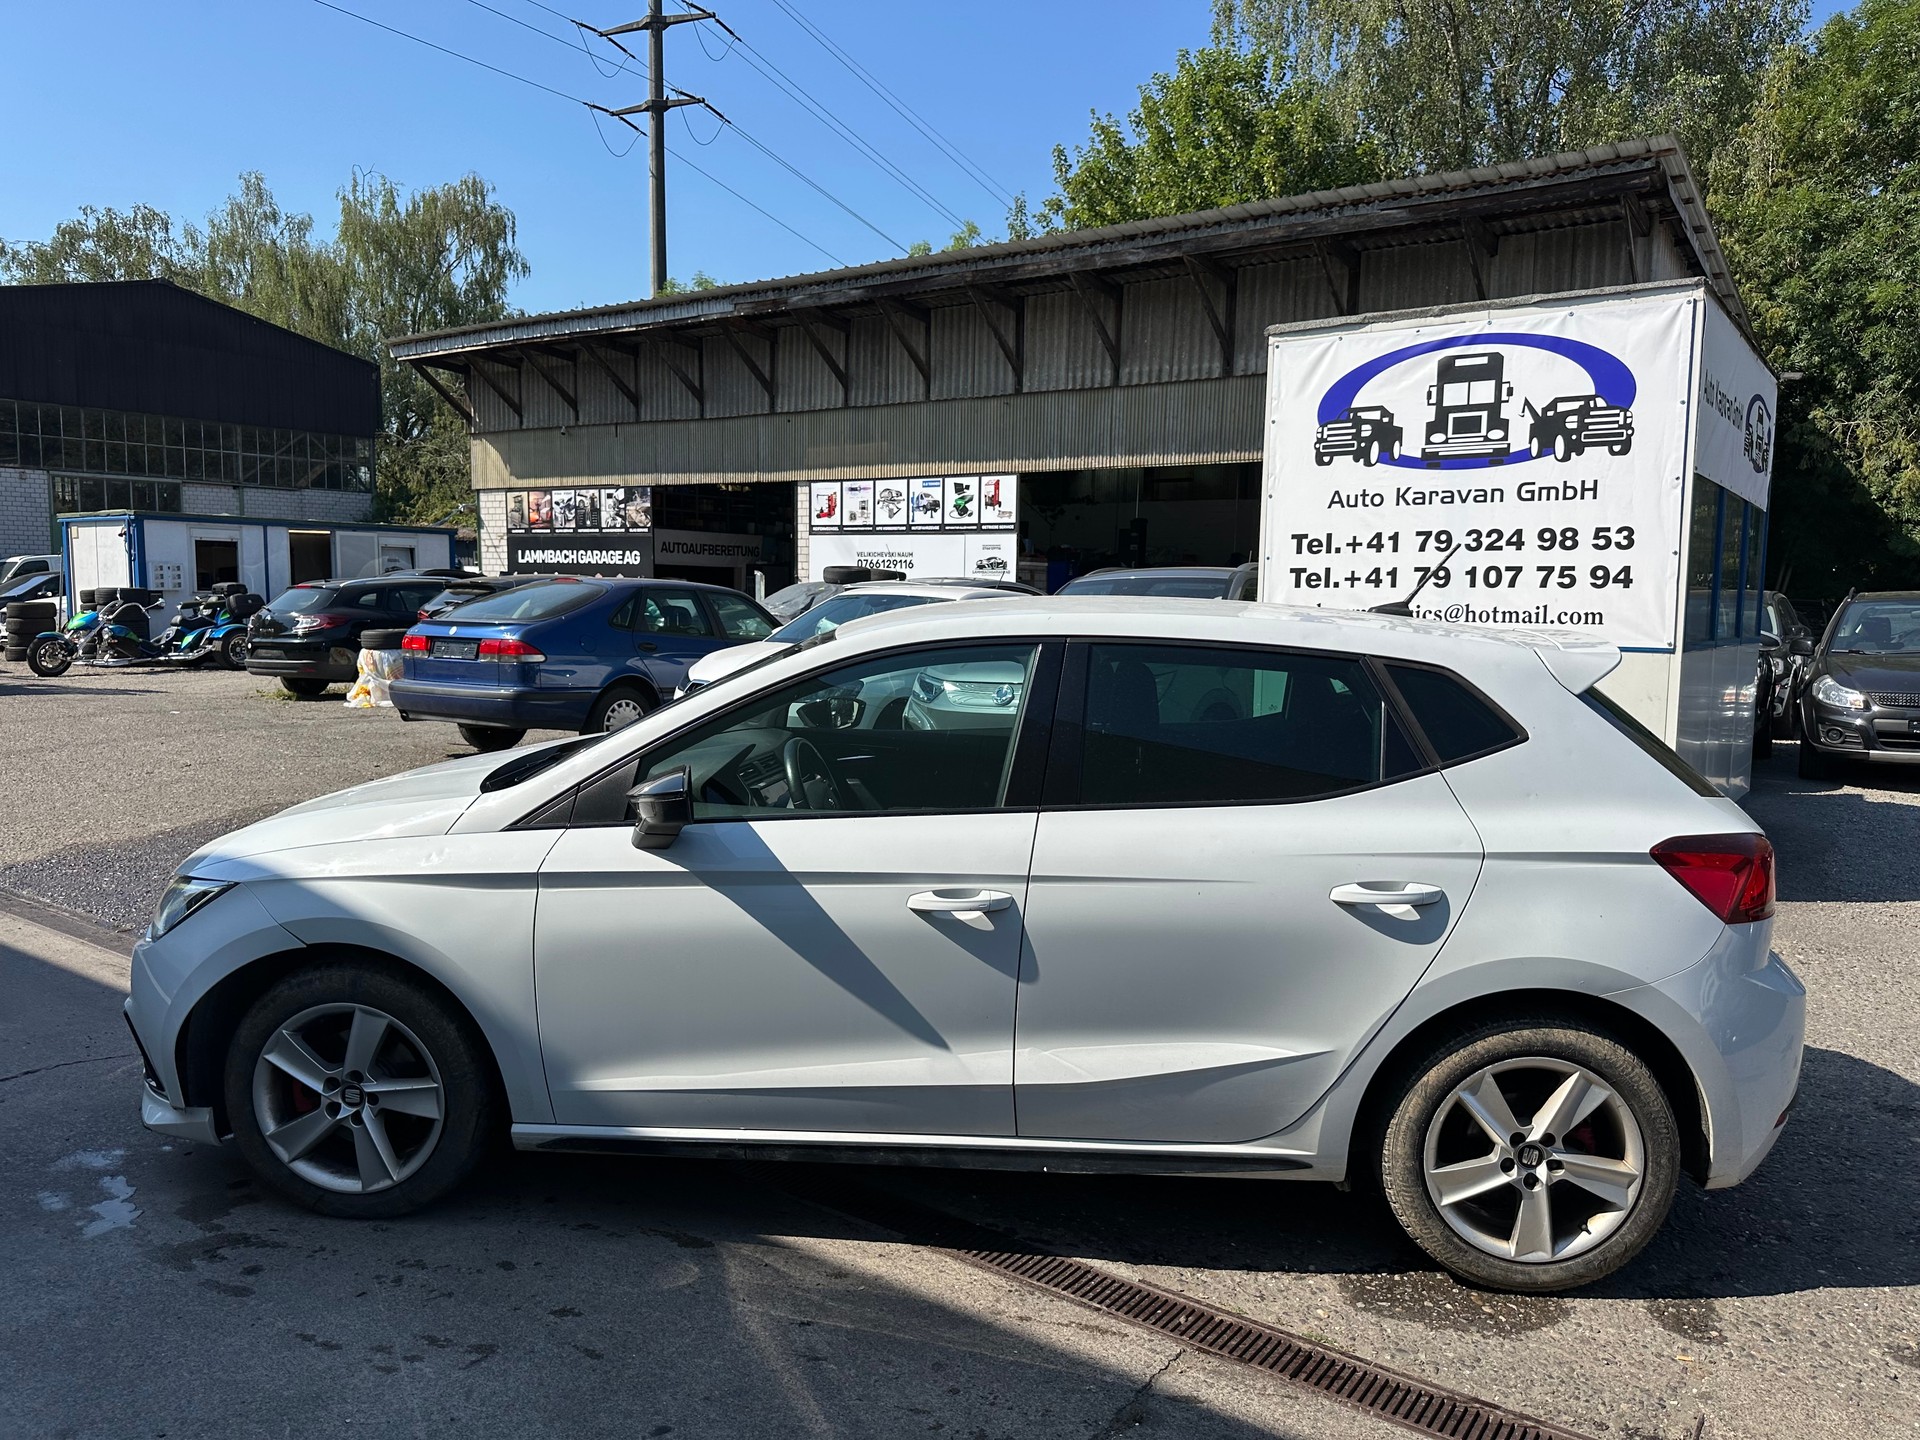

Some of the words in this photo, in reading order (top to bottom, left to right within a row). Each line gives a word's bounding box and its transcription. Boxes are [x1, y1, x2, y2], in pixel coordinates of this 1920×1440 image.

[1327, 489, 1385, 509] Auto
[1395, 486, 1505, 507] Karavan
[1516, 479, 1599, 502] GmbH
[661, 541, 760, 557] AUTOAUFBEREITUNG
[1291, 531, 1400, 554] Tel.+41
[1416, 530, 1453, 553] 79
[1464, 528, 1526, 552] 324
[1537, 527, 1580, 552] 98
[1592, 526, 1635, 550] 53
[518, 549, 577, 564] LAMMBACH
[578, 550, 623, 564] GARAGE
[623, 550, 641, 565] AG
[857, 559, 914, 569] 0766129116
[1290, 567, 1398, 589] Tel.+41
[1413, 566, 1452, 589] 79
[1464, 566, 1524, 589] 107
[1536, 566, 1577, 589] 75
[1589, 565, 1633, 589] 94
